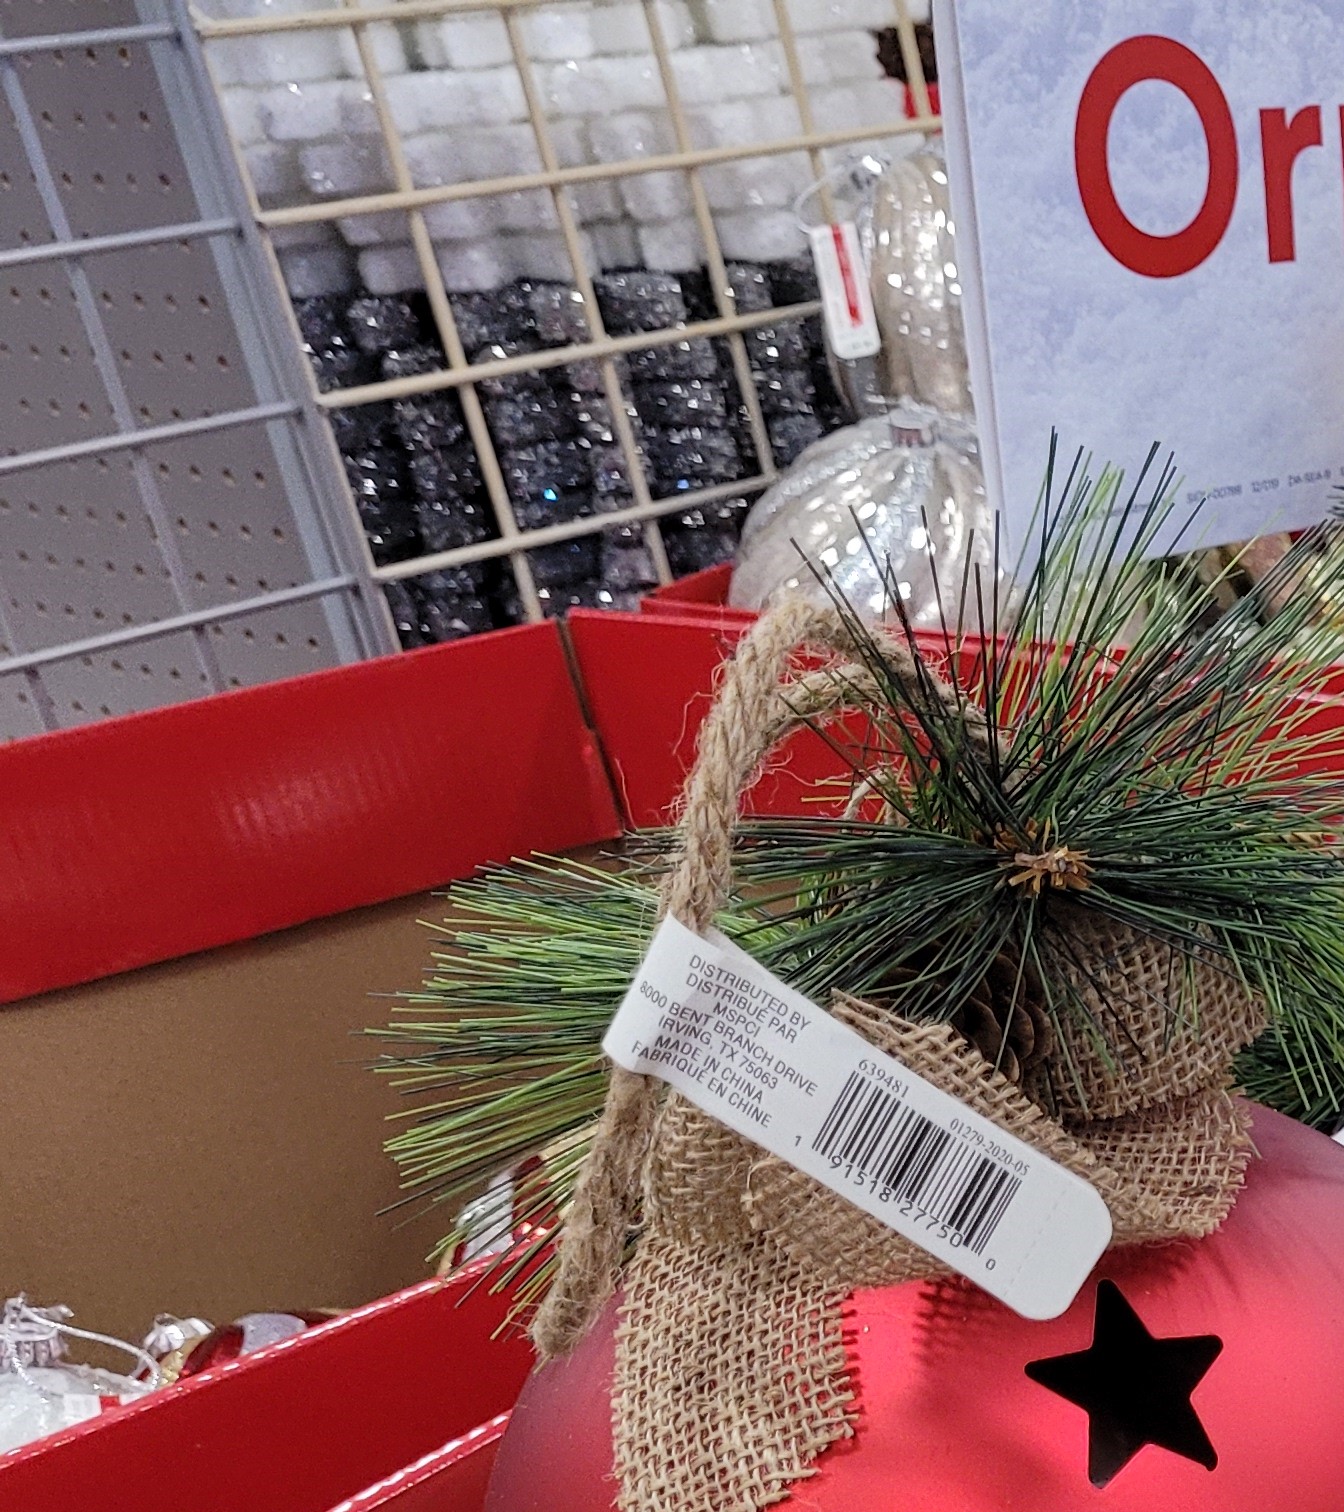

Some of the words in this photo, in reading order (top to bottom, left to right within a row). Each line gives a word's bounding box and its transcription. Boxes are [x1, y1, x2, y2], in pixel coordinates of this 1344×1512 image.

[686, 973, 769, 1023] DISTRIBUÉ
[768, 1021, 797, 1043] PAR
[690, 955, 788, 1016] DISTRIBUTED
[790, 1011, 811, 1031] BY
[713, 1002, 761, 1037] MSPCI
[640, 981, 668, 1008] 8000
[668, 1002, 714, 1028] BENT
[714, 1021, 774, 1066] BRANCH
[774, 1060, 818, 1096] DRIVE
[655, 1035, 701, 1065] MADE
[703, 1055, 721, 1073] IN
[721, 1068, 763, 1104] CHINA
[659, 1015, 712, 1049] IRVING,
[719, 1041, 739, 1062] TX
[738, 1057, 778, 1089] 75063
[707, 1079, 728, 1097] EN
[728, 1092, 772, 1128] CHINE
[858, 1059, 909, 1098] 639481
[950, 1118, 1031, 1176] 01279-2020-05
[794, 1135, 802, 1147] 1
[829, 1155, 892, 1203] 91518
[899, 1201, 964, 1248] 27750
[985, 1258, 997, 1271] 0
